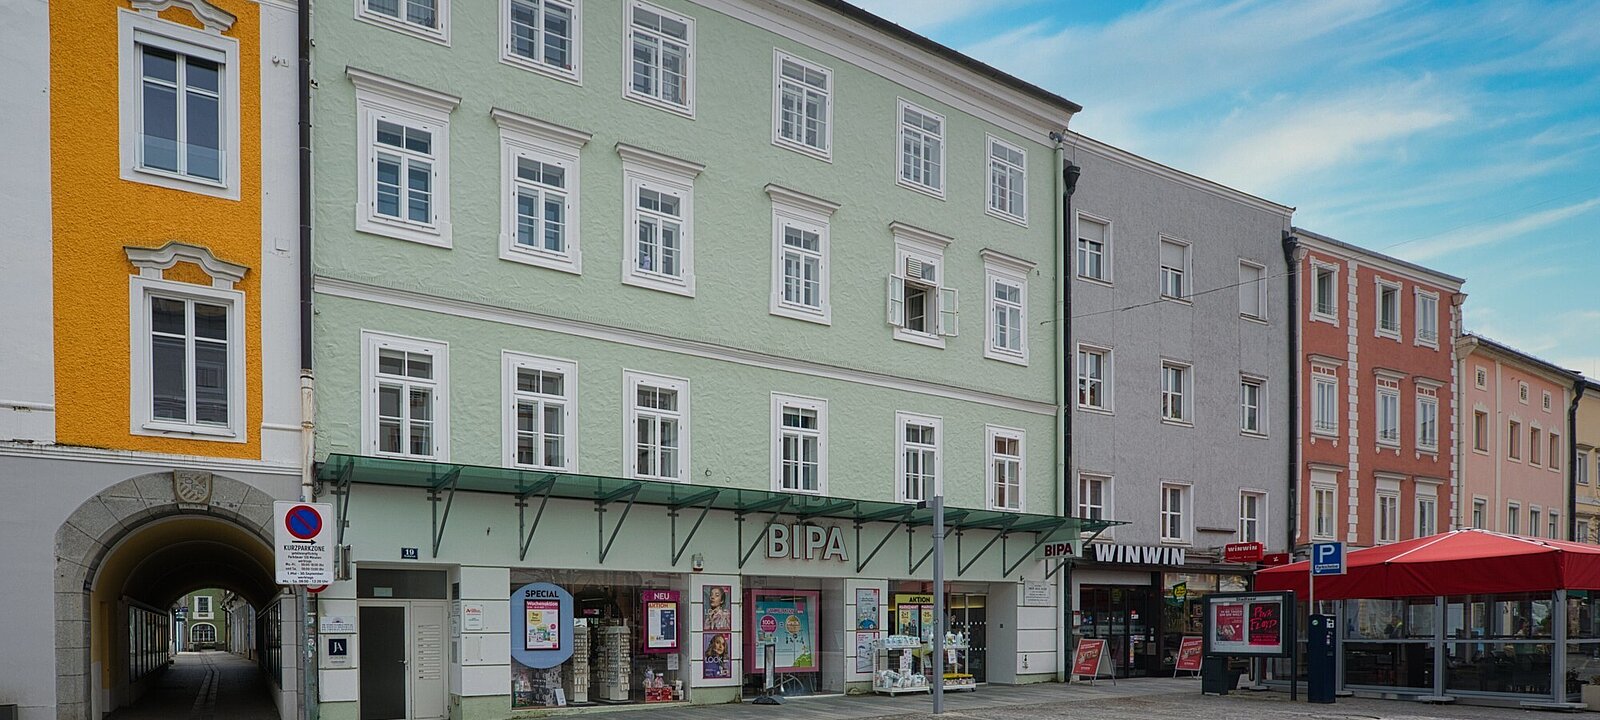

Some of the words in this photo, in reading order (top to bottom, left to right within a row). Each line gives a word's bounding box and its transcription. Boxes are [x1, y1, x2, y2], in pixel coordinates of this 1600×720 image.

[767, 523, 849, 561] BIPA
[1044, 542, 1073, 557] BIPA
[1094, 543, 1186, 566] WINWIN
[1320, 544, 1335, 563] P
[525, 590, 559, 598] SPECIAL
[653, 592, 670, 600] NEU
[704, 656, 723, 664] LOOK
